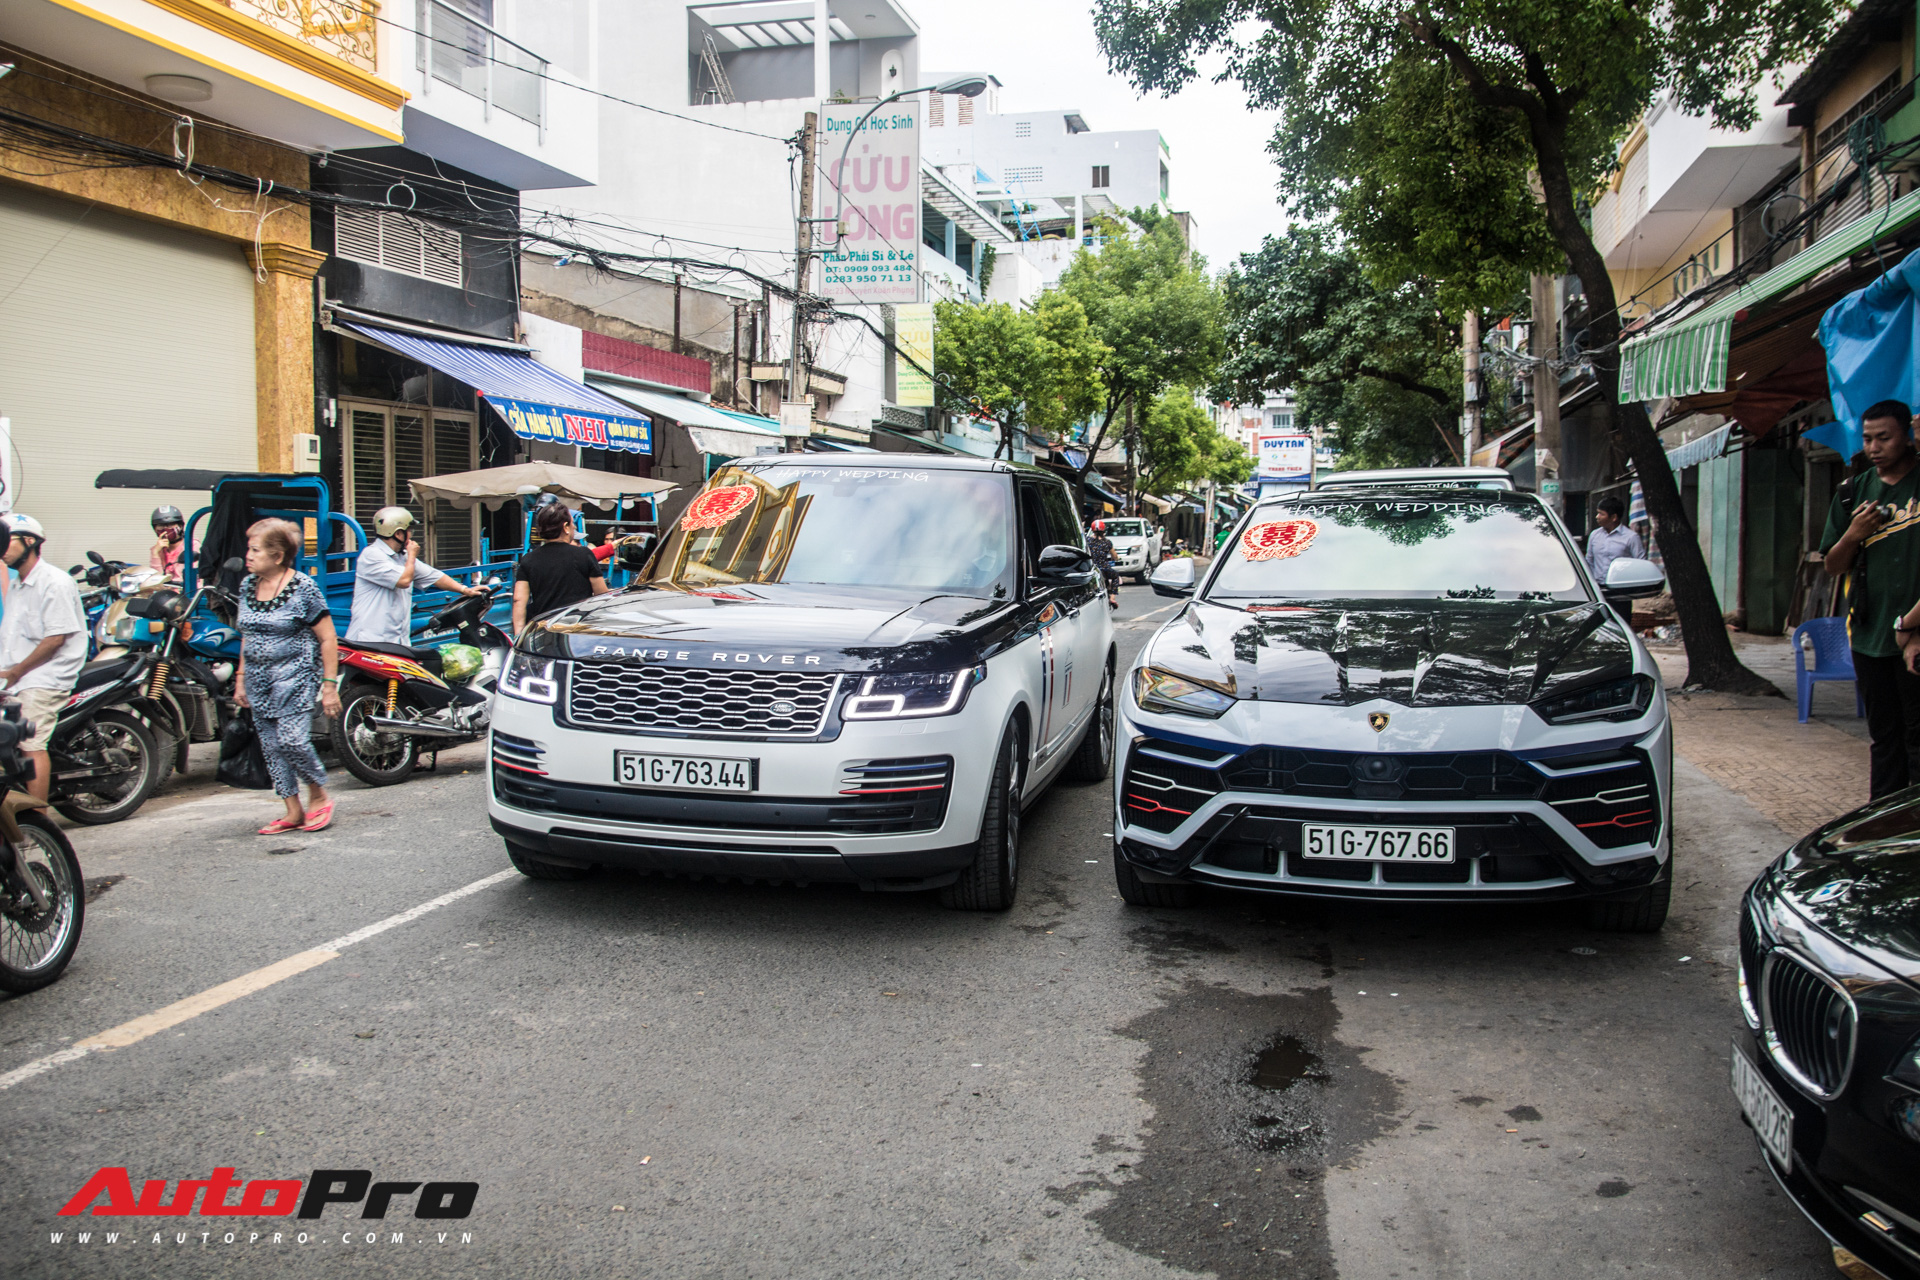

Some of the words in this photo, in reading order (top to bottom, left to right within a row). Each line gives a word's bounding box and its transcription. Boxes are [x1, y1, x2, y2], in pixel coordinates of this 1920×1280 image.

[827, 117, 852, 135] Dụng
[870, 116, 888, 134] Học
[891, 114, 913, 129] Sinh
[829, 143, 910, 193] CỬU
[824, 203, 915, 241] LONG
[887, 249, 896, 260] &
[825, 275, 852, 283] 0283
[880, 274, 894, 282] 71
[898, 274, 911, 282] 13
[844, 265, 868, 273] 0909
[563, 414, 608, 444] NHI
[776, 468, 830, 480] HAPPY
[839, 469, 929, 482] WEDDING
[1285, 502, 1363, 517] HAPPY
[1375, 501, 1506, 516] WEDDING
[593, 645, 691, 661] RANGE
[712, 652, 820, 665] ROVER
[623, 757, 745, 788] 51G-763.44
[1309, 828, 1448, 858] 51G-767.66
